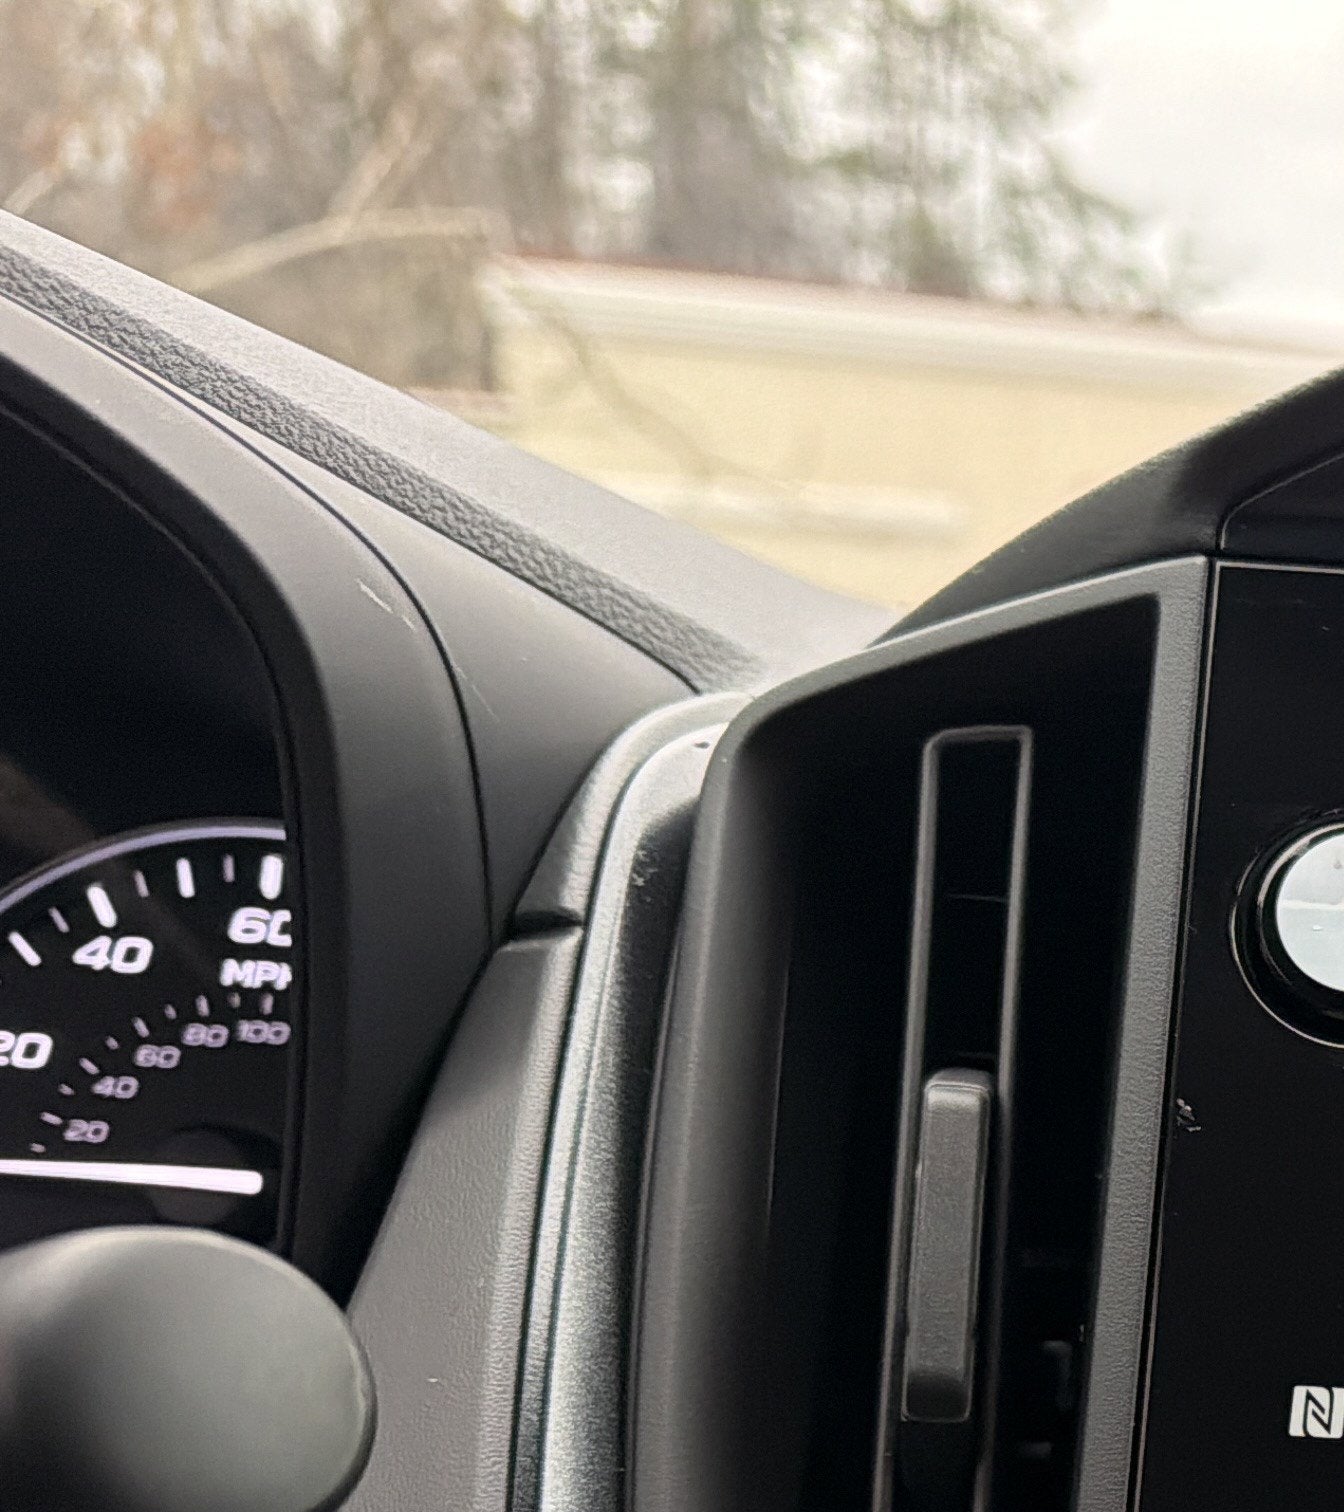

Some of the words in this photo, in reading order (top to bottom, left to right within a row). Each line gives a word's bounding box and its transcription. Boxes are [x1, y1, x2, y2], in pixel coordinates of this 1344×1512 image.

[72, 935, 154, 974] 40
[237, 1019, 292, 1046] 100
[91, 1075, 140, 1100] 40
[63, 1118, 110, 1144] 20
